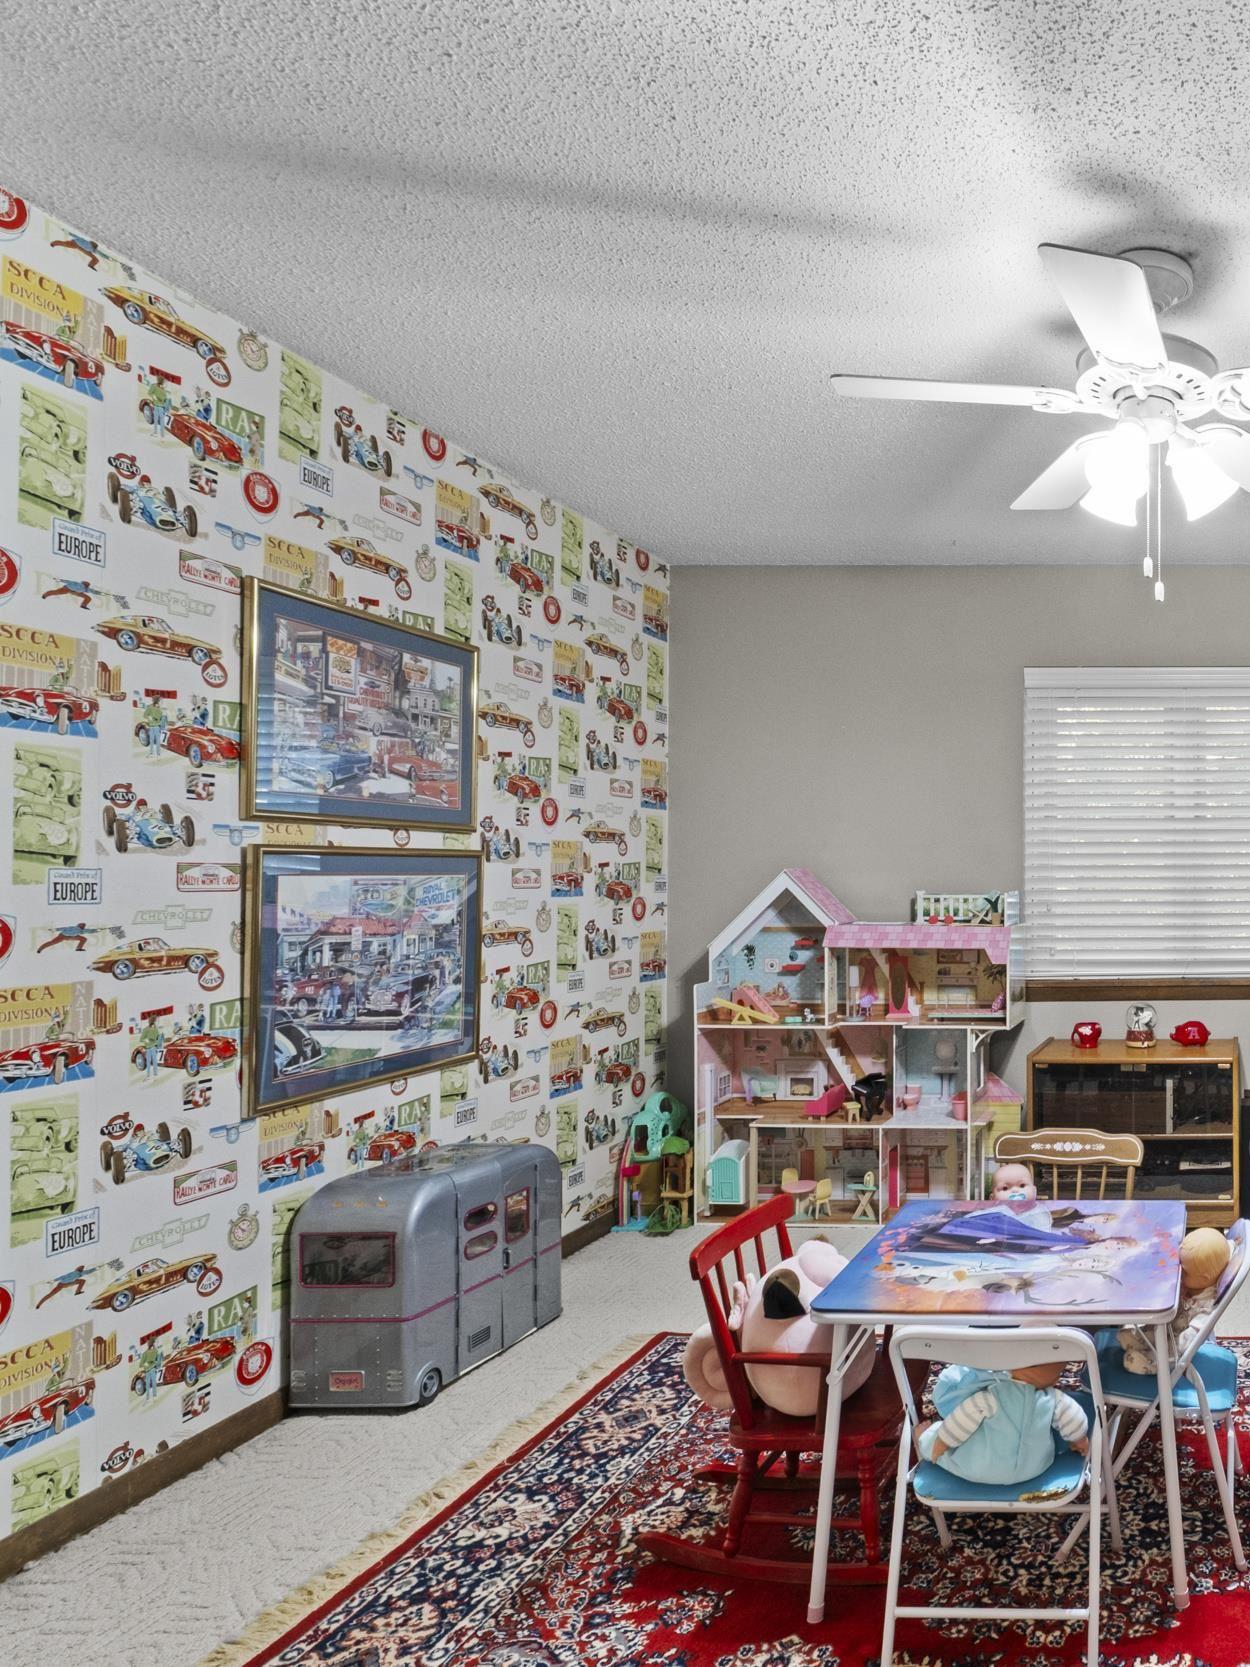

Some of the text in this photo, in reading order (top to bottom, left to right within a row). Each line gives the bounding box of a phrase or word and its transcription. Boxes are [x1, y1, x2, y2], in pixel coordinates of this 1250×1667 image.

[8, 260, 66, 301] SCCA
[111, 458, 140, 476] VOLVO
[303, 468, 330, 494] EUROPE
[58, 532, 103, 563] EUROPE
[268, 536, 306, 560] SCCA
[0, 623, 60, 649] SCCA
[105, 791, 137, 802] VOLVO
[267, 824, 304, 836] SCCA
[179, 873, 200, 886] RALLYE
[53, 882, 98, 901] EUROPE
[416, 890, 458, 907] CHEVROLET
[0, 986, 54, 1002] SCCA
[1187, 1026, 1200, 1039] A
[457, 1107, 476, 1126] EUROPE
[103, 1120, 133, 1134] VOLVO
[176, 1184, 197, 1199] RALLYE
[52, 1222, 96, 1252] EUROPE
[0, 1340, 54, 1369] SCCA
[104, 1450, 133, 1472] VOLVO
